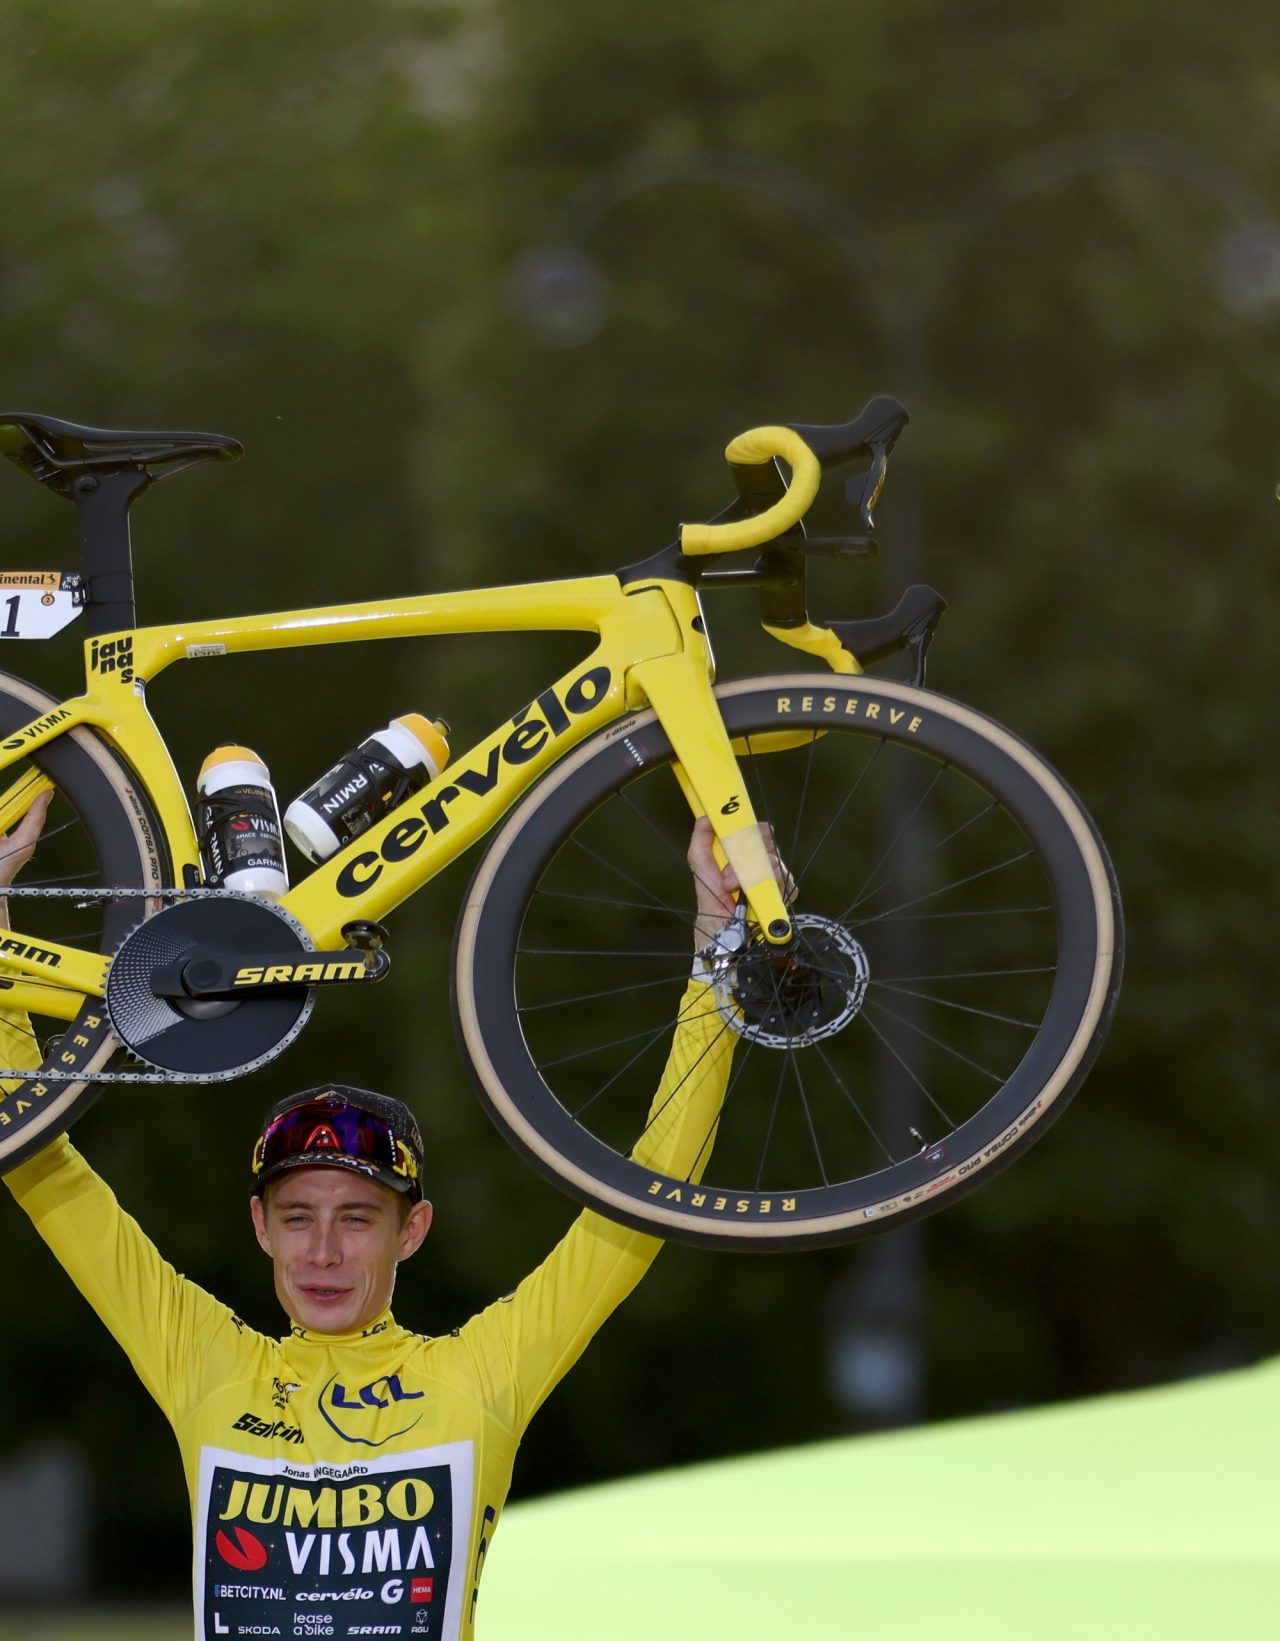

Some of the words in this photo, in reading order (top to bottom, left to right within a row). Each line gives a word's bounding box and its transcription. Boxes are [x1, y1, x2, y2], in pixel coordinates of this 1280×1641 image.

[0, 595, 21, 638] 1
[24, 709, 72, 739] VISMA
[776, 696, 923, 734] RESERVE
[335, 666, 612, 898] cervélo
[233, 961, 368, 986] SRAM
[647, 1180, 797, 1214] RESERVE
[331, 1374, 425, 1410] LCL
[282, 1466, 310, 1478] Jonas
[219, 1478, 435, 1529] JUMBO
[284, 1526, 435, 1576] VISMA
[220, 1585, 287, 1601] BETCITY.NL
[295, 1588, 375, 1602] cervélo
[380, 1579, 404, 1605] G
[413, 1586, 432, 1595] HEMA
[293, 1612, 333, 1624] lease
[347, 1625, 402, 1635] SRAM
[411, 1626, 430, 1634] AGU
